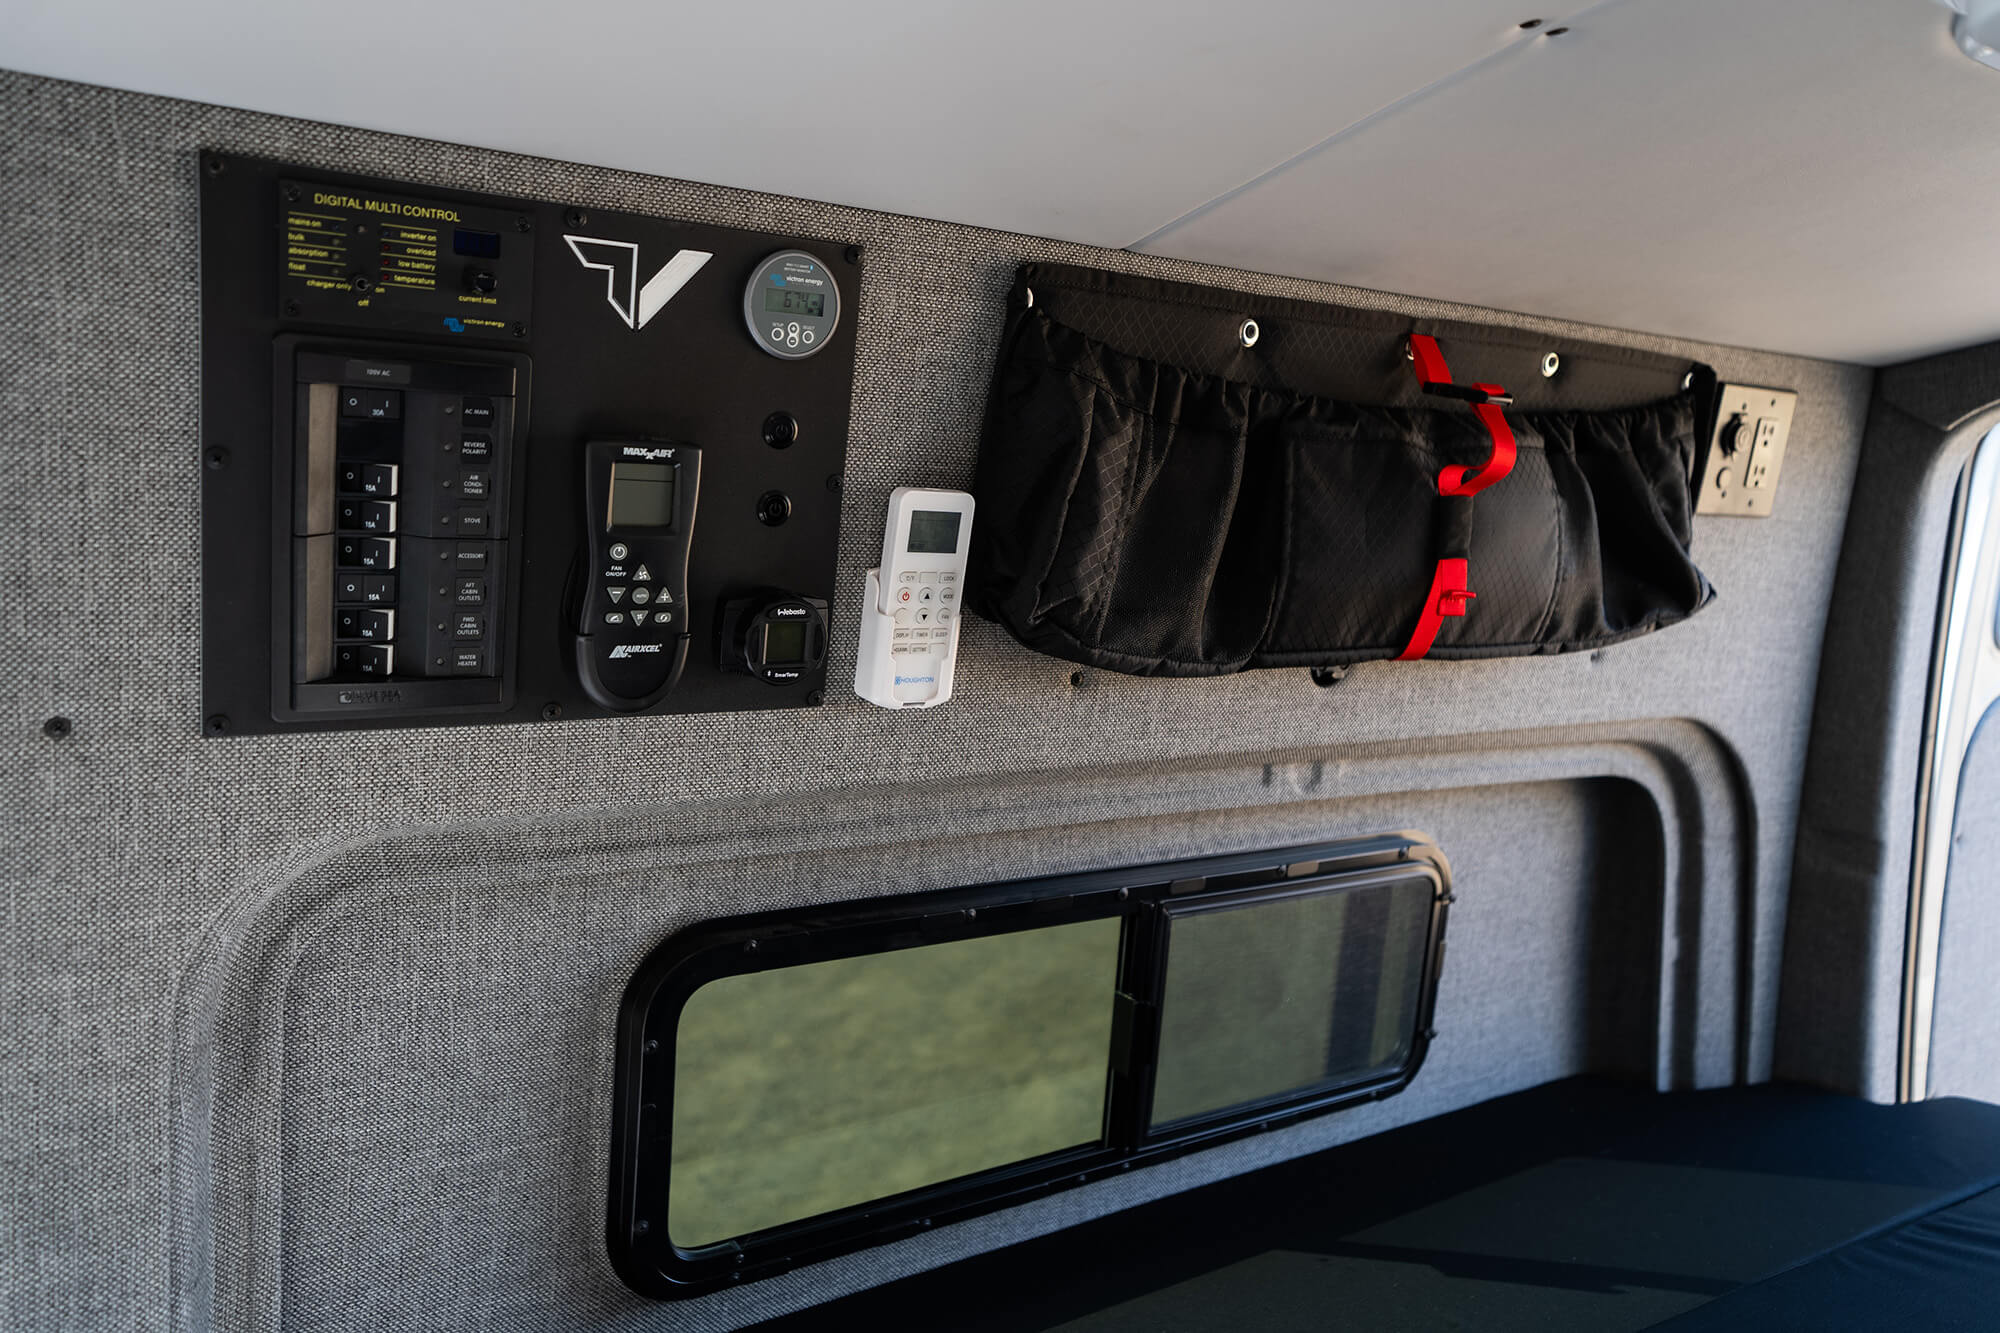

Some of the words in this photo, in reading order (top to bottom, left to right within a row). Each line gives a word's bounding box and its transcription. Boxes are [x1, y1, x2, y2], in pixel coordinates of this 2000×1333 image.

[313, 192, 363, 210] DIGITAL
[364, 200, 401, 215] MULTI
[402, 205, 462, 223] CONTROL
[287, 217, 311, 226] mains
[311, 220, 322, 228] on
[287, 232, 305, 241] bulk
[400, 231, 427, 241] inverter
[428, 234, 438, 242] on
[287, 246, 329, 257] absorption
[405, 246, 438, 257] overload
[287, 262, 307, 272] float
[398, 259, 411, 268] low
[411, 261, 437, 272] battery
[393, 274, 437, 285] temperature
[786, 274, 804, 282] victron
[805, 278, 823, 287] energy
[306, 279, 336, 290] charger
[335, 282, 353, 292] only
[357, 298, 370, 307] off
[457, 295, 482, 303] current
[482, 297, 497, 305] limit
[485, 320, 506, 328] energy
[463, 441, 486, 449] REVERSE
[365, 484, 376, 492] 15A
[364, 520, 376, 529] 15A
[363, 557, 375, 566] 15A
[368, 593, 381, 601] 15A
[777, 608, 806, 616] Webasto
[362, 629, 374, 638] 15A
[625, 644, 661, 653] AIRXCEL
[362, 664, 373, 672] 15A
